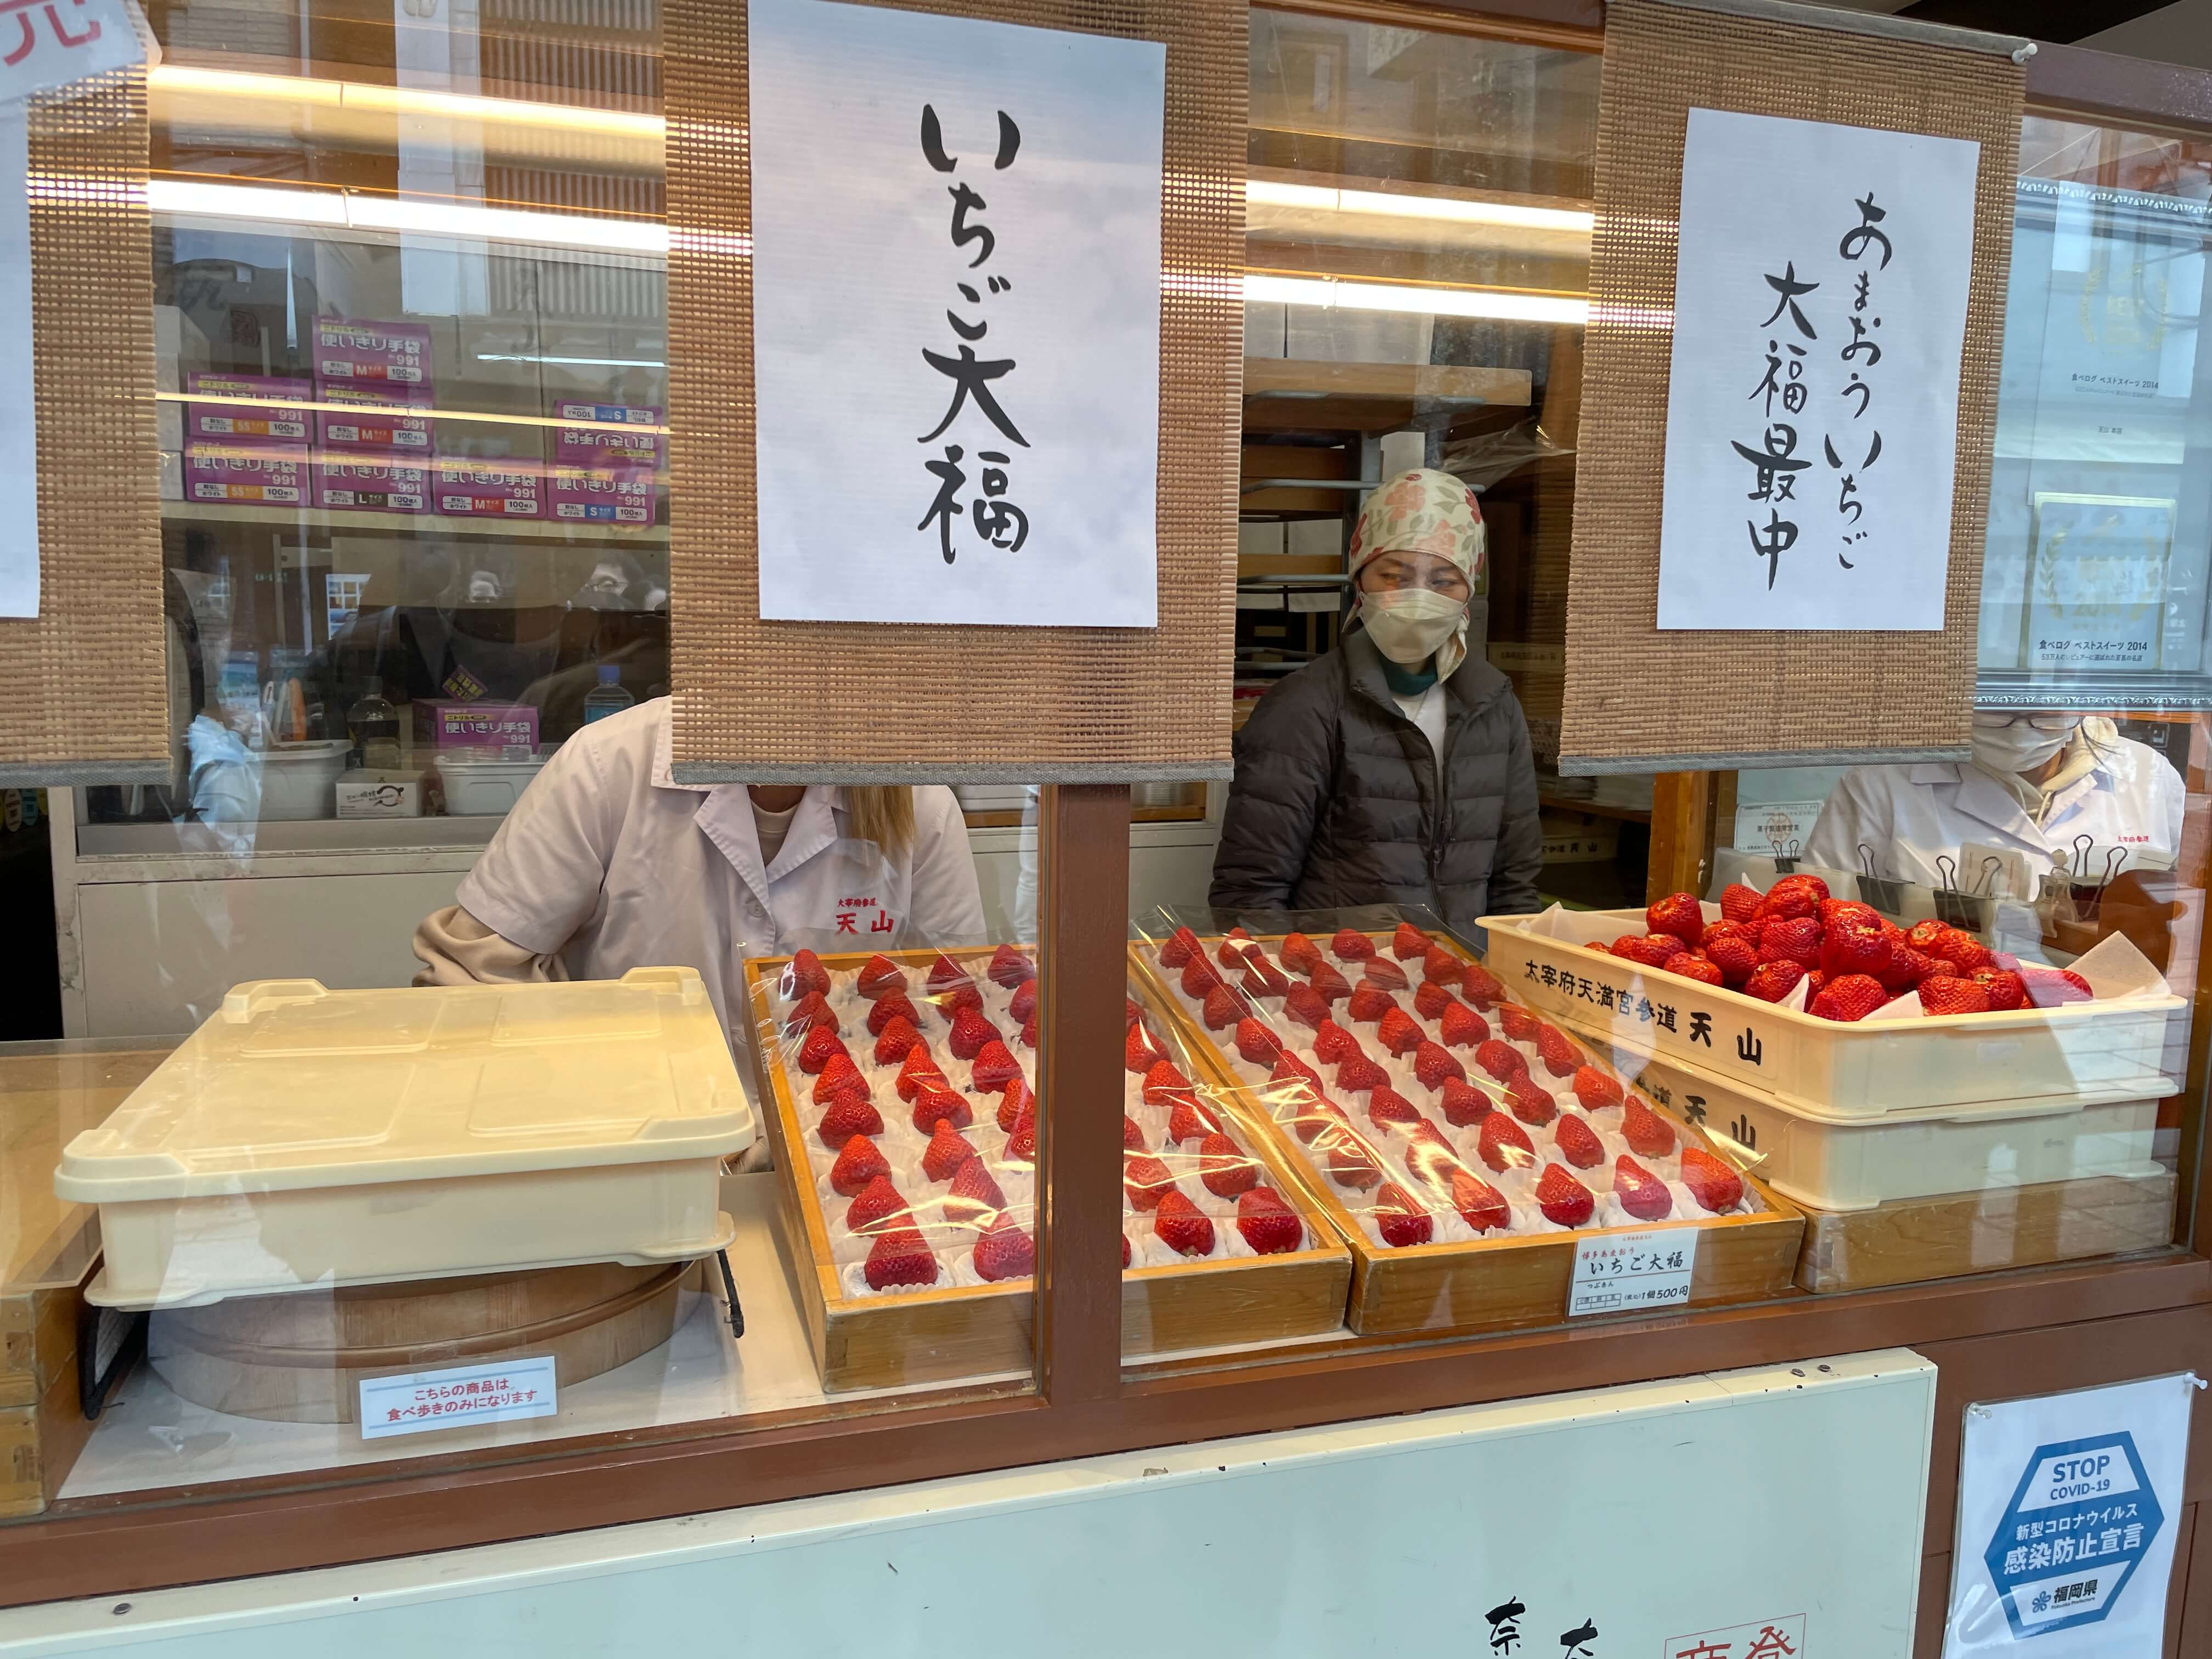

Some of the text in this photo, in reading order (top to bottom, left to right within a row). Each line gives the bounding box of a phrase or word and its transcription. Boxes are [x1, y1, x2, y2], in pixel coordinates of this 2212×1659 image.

[321, 334, 420, 354] 使いきり手袋
[918, 104, 1031, 564] いちご大福
[2072, 373, 2159, 389] 食べログ ベストスイーツ 2014
[1731, 261, 1820, 591] 大福最中
[556, 478, 647, 495] 使いきり手袋
[2039, 640, 2147, 651] 食べログ ベストスイーツ 2014
[445, 722, 531, 733] 使いきり手袋
[1524, 960, 1677, 1033] 太宰府天満宮参道
[1582, 1247, 1634, 1260] 博多あまおう
[1591, 1251, 1683, 1274] いちご大福
[414, 1378, 509, 1401] こちらの商品は
[387, 1389, 537, 1421] 食べ歩きのみになります
[2053, 1455, 2110, 1483] STOP
[2050, 1479, 2111, 1500] COVID-19
[2016, 1503, 2138, 1542] 新型コロナウイルス
[2003, 1522, 2144, 1576] 感染防止宣言
[2053, 1579, 2098, 1604] 福岡県
